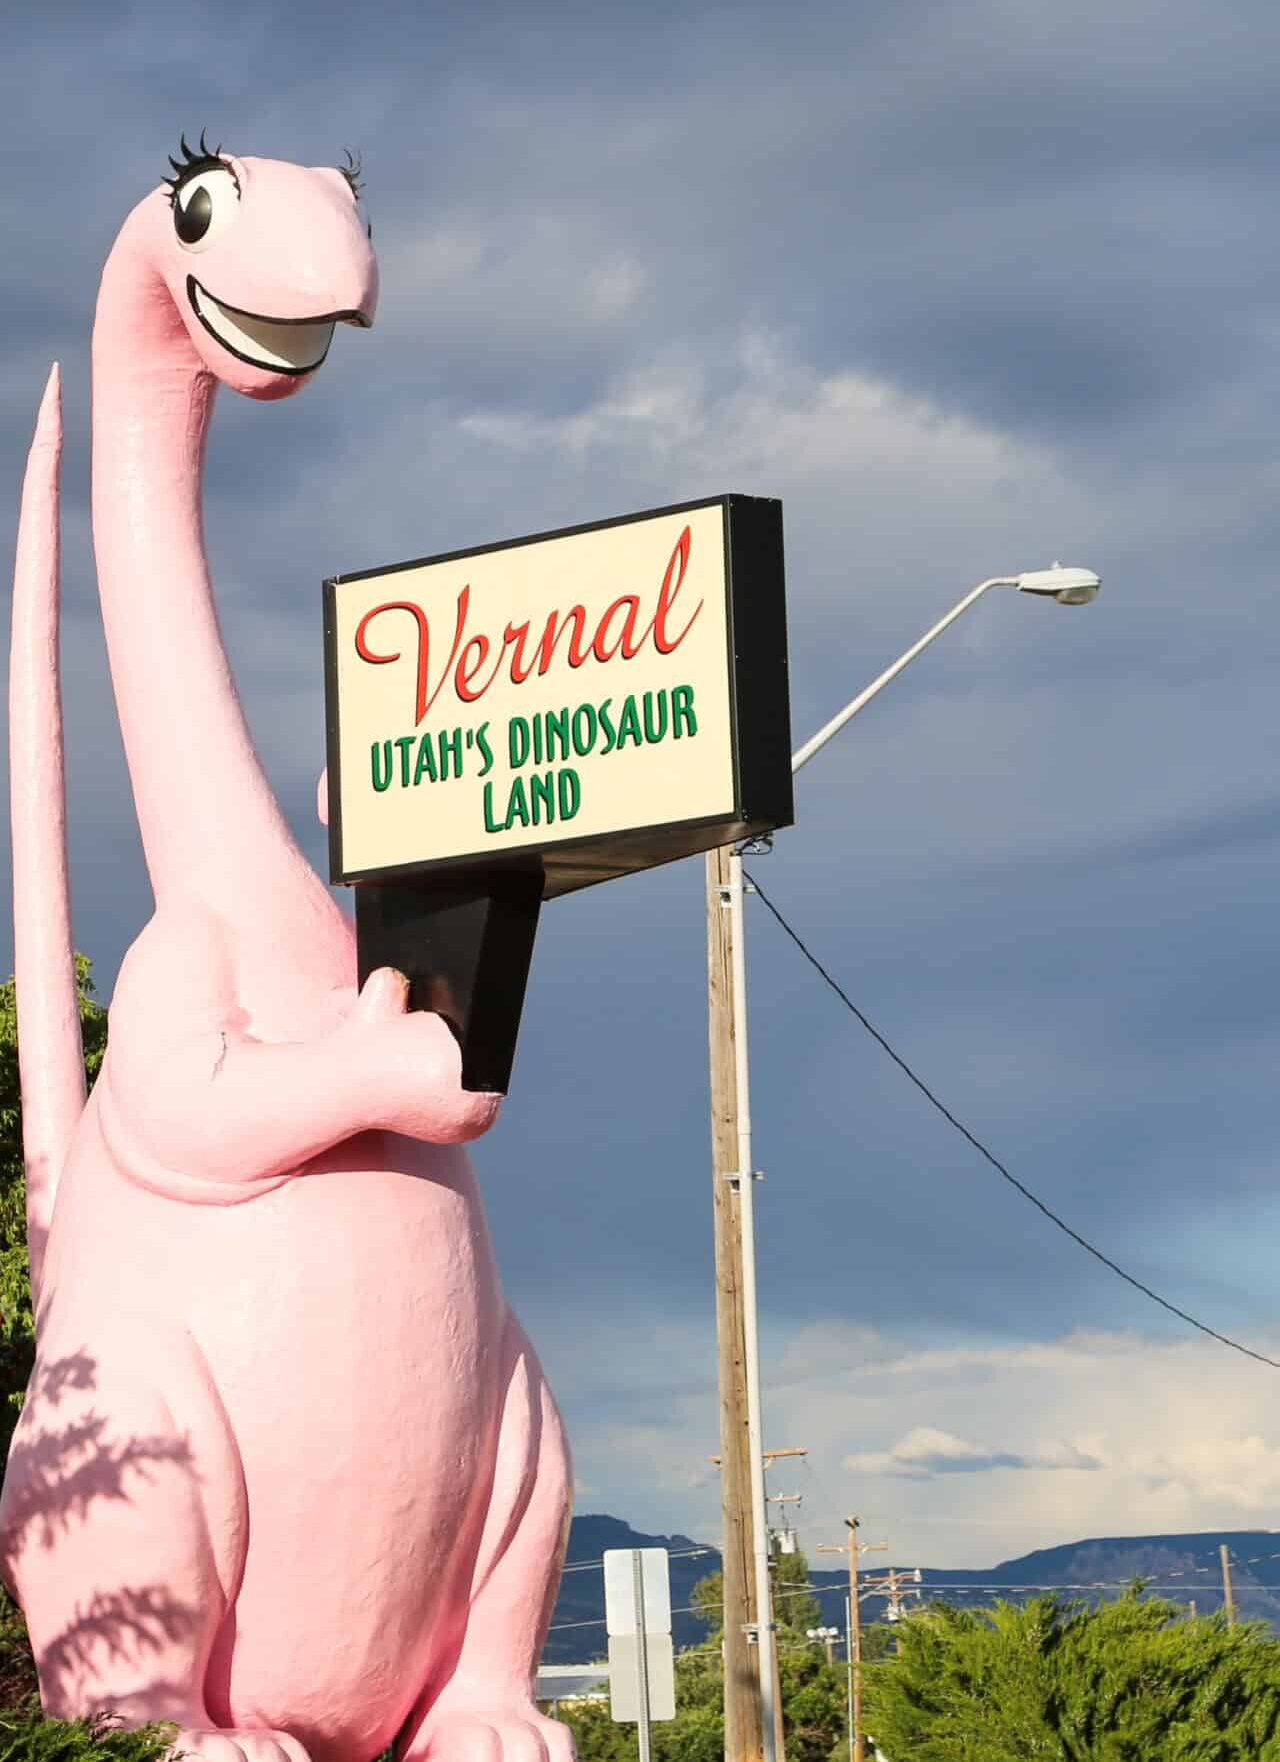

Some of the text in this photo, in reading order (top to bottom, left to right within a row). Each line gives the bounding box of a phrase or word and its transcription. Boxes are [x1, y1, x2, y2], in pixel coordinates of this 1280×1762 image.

[354, 525, 704, 727] Vernal
[370, 684, 698, 792] UTAH'S DINOSAUR
[483, 767, 582, 832] LAND
